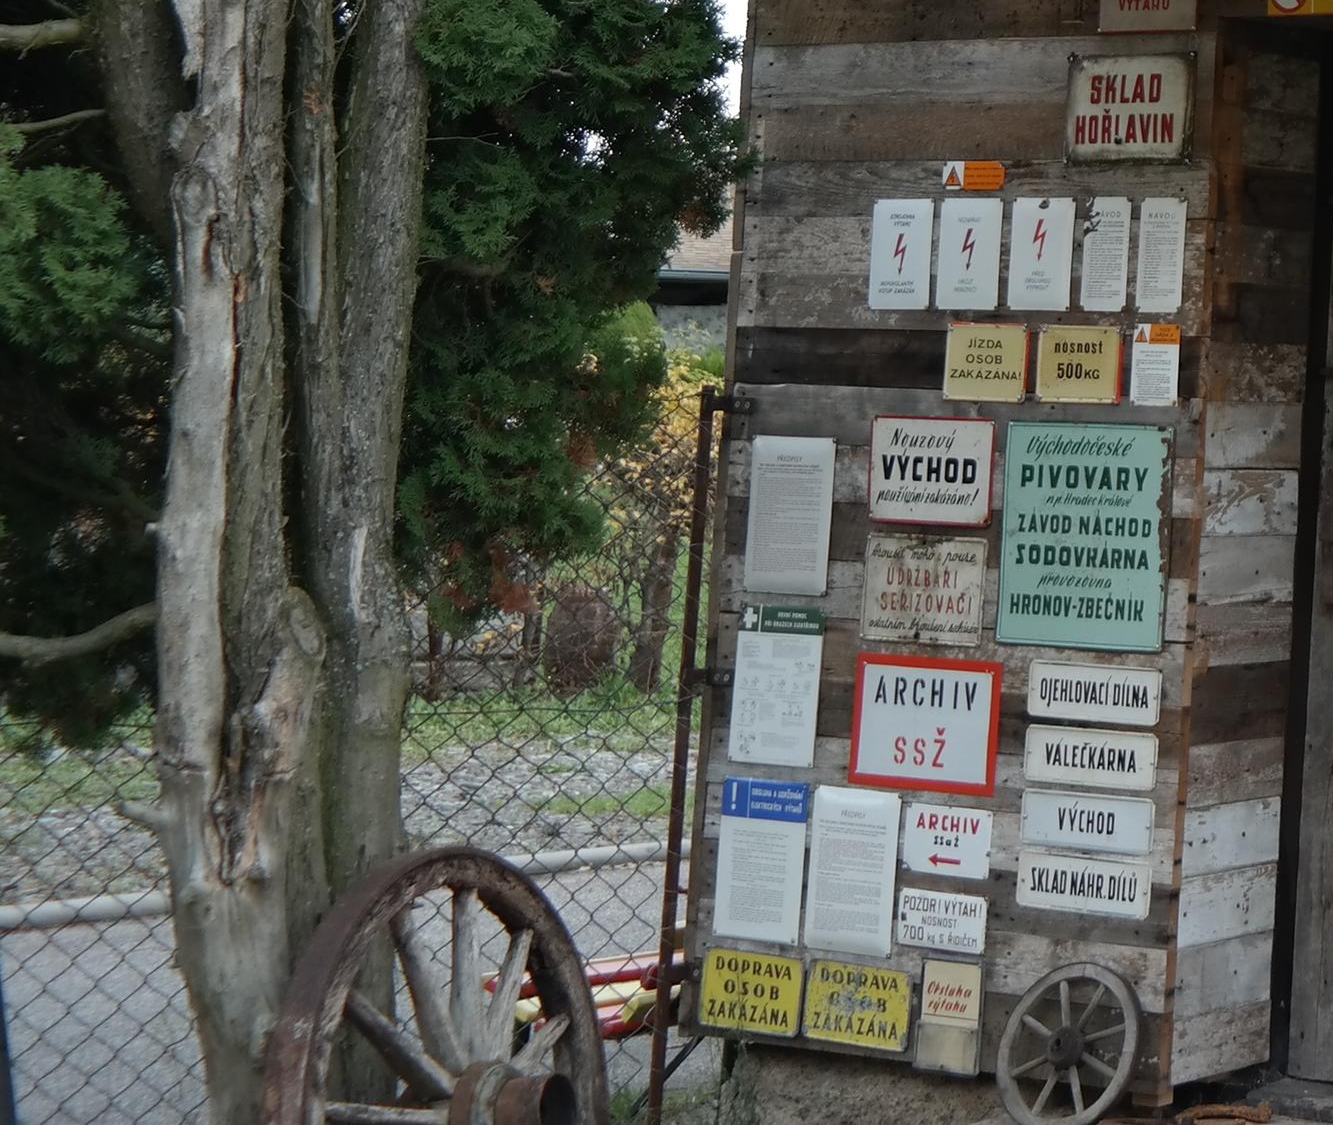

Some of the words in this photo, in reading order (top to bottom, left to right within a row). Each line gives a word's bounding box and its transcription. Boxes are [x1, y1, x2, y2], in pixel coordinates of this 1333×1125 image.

[1090, 74, 1162, 104] SKLAD
[967, 336, 1003, 349] JÍZDA
[1054, 340, 1103, 354] nosnost
[965, 354, 1003, 364] OSOB
[890, 427, 957, 453] Nouzový
[1026, 434, 1136, 461] Východočeské
[882, 448, 977, 484] VÝCHOD
[1020, 463, 1149, 491] PIVOVARY
[1018, 507, 1071, 534] ZÁVOD
[1078, 509, 1152, 538] NÁCHOD
[1015, 540, 1149, 570] SODOVKÁRNA
[1037, 573, 1112, 589] provozovna
[1009, 591, 1144, 622] HRONOV-ZBEČNÍK
[874, 675, 978, 711] ARCHIV
[1040, 675, 1112, 708] OJEHLOVACÍ
[1112, 676, 1149, 709] DÍLNA
[893, 727, 947, 768] SSŽ
[1045, 738, 1136, 773] VÁLEČKÁRNA
[916, 811, 981, 835] ARCHIV
[1058, 801, 1115, 835] VÝCHOD
[1030, 867, 1066, 894] SKLAD
[1070, 866, 1107, 899] NÁHR.
[1108, 869, 1138, 903] DÍLŮ
[903, 925, 923, 940] 700
[927, 934, 936, 945] kg
[948, 931, 978, 948] ŘIDIČEM
[921, 917, 958, 929] NOSNOST
[716, 956, 792, 980] DOPRAVA
[820, 967, 899, 992] DOPRAVA
[724, 979, 780, 1001] OSOB
[927, 980, 973, 999] Obsluha
[708, 999, 789, 1028] ZAKÁZÁNA
